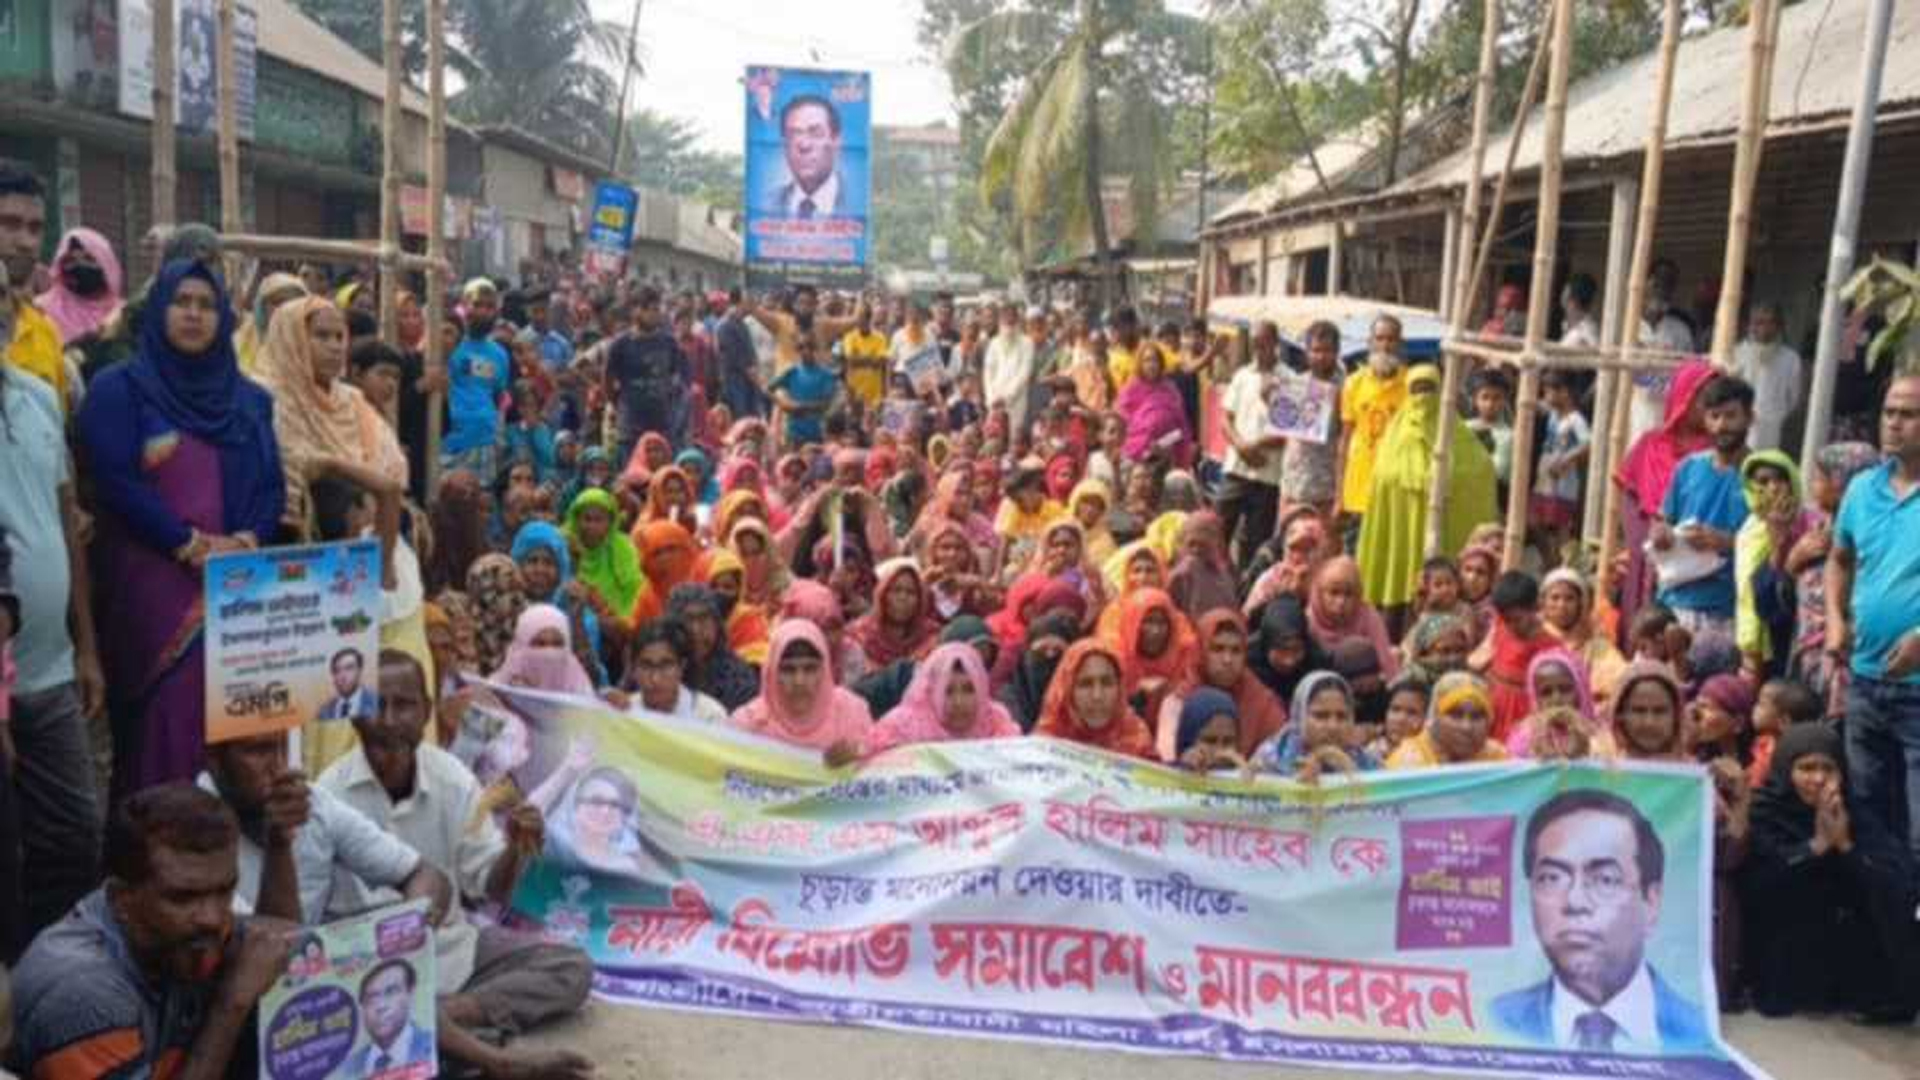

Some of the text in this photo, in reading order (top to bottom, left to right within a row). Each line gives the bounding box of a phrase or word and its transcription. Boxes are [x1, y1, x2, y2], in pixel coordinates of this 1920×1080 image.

[1043, 794, 1167, 848] হালিম
[1183, 818, 1313, 870] সাহেব
[1330, 834, 1391, 876] কে
[1013, 865, 1123, 908] দেওয়ার
[930, 922, 1148, 994] সমাবেশ
[1158, 958, 1189, 998] ও
[1195, 945, 1477, 1032] মানববন্ধন
